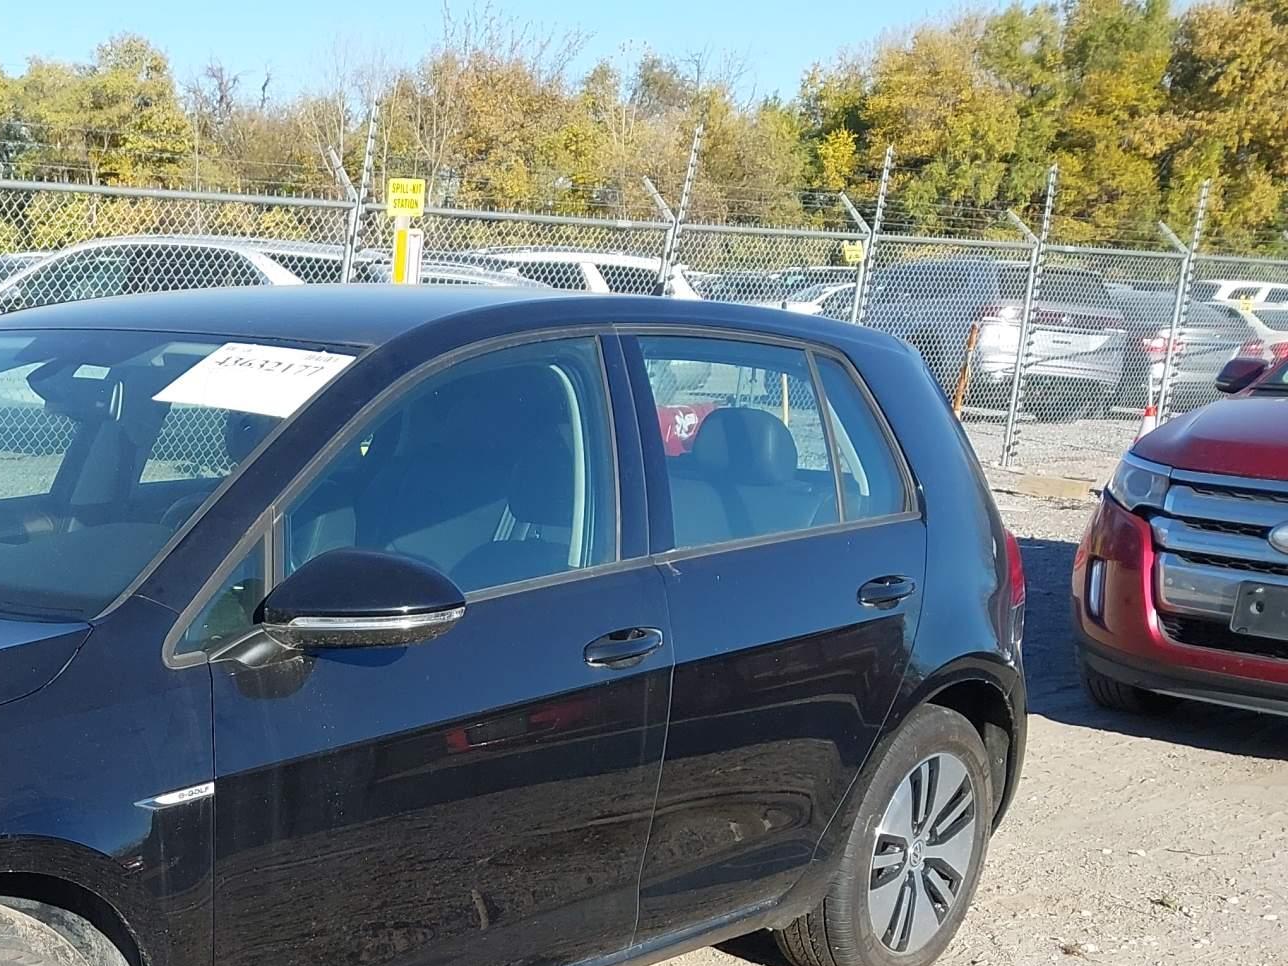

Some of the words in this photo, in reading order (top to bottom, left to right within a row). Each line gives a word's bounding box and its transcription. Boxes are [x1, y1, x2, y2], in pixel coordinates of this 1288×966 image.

[392, 182, 409, 194] SPILL
[412, 183, 422, 194] KIT
[393, 198, 419, 209] STATION
[215, 356, 325, 377] 43632177
